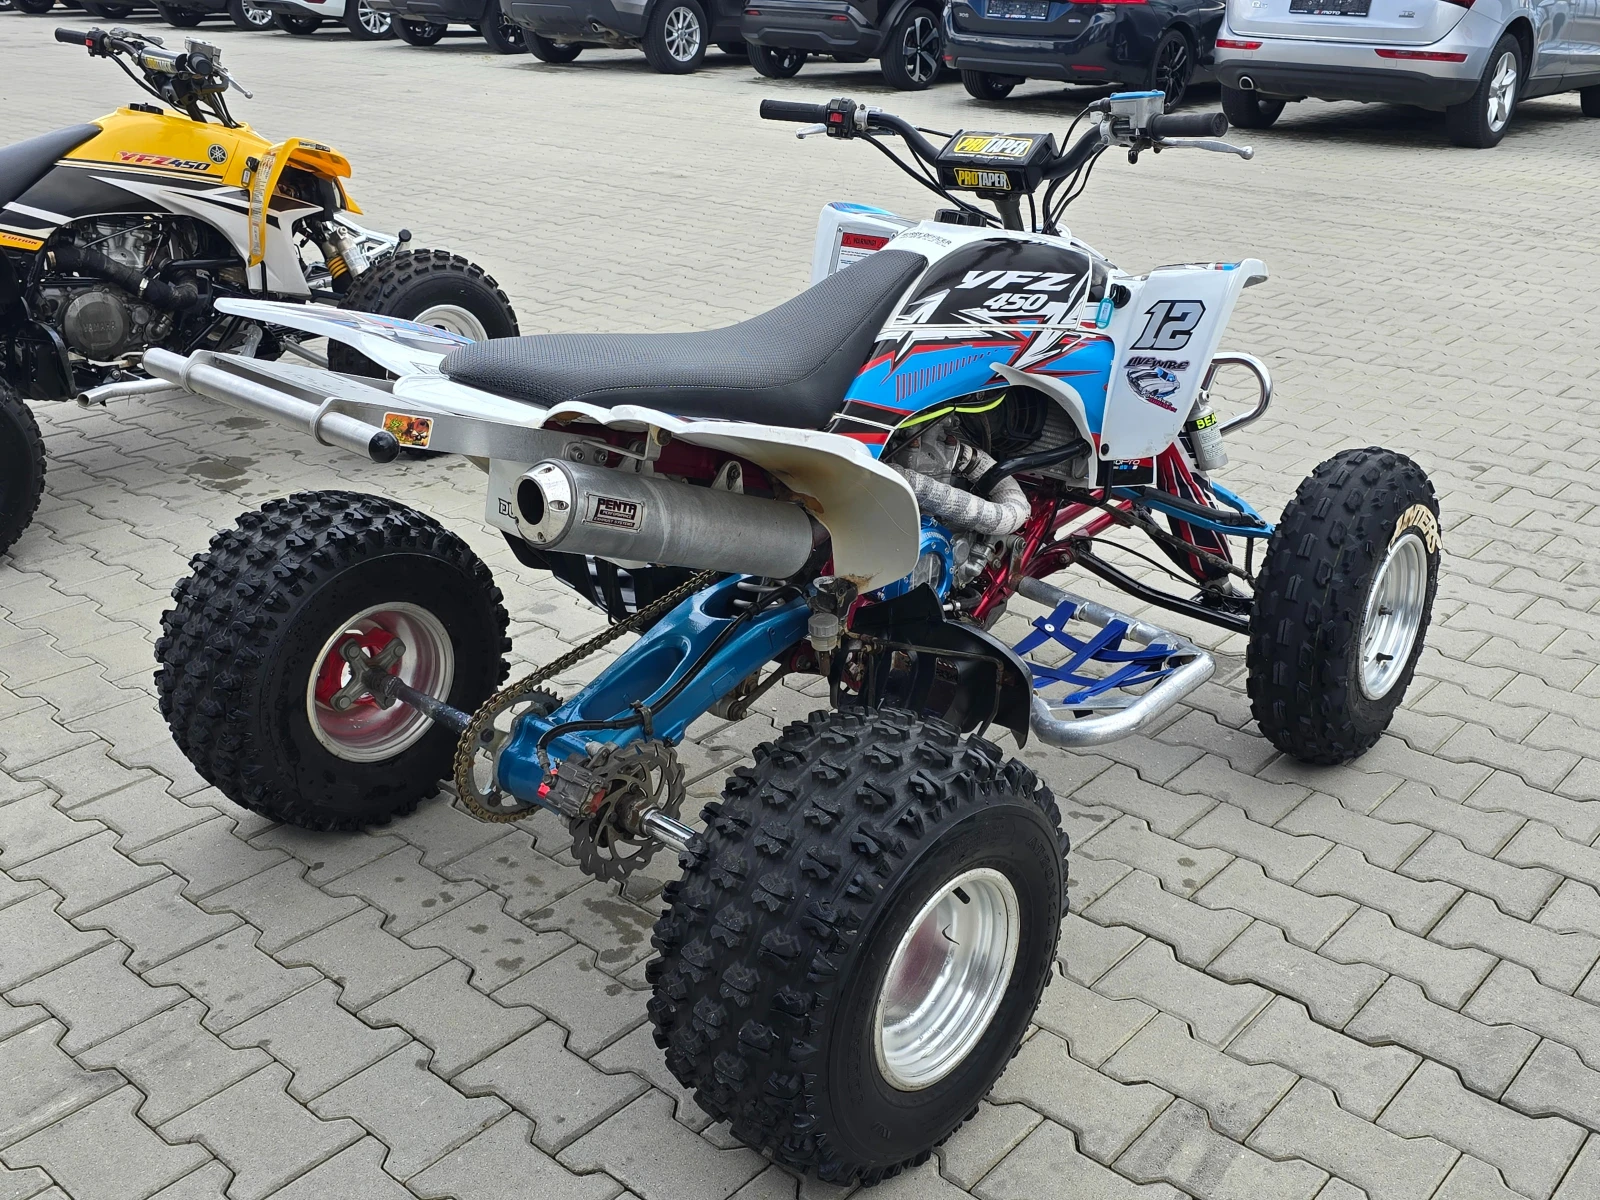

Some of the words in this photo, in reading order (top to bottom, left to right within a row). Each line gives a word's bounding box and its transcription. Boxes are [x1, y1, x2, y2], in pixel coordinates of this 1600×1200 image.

[958, 137, 1030, 155] PROTAPER
[958, 169, 1008, 188] PROTAPER
[954, 270, 1077, 291] YFZ
[982, 292, 1049, 311] 450
[1129, 299, 1206, 350] 12
[1124, 355, 1190, 371] LIVEWIRE
[594, 498, 638, 518] PENTA
